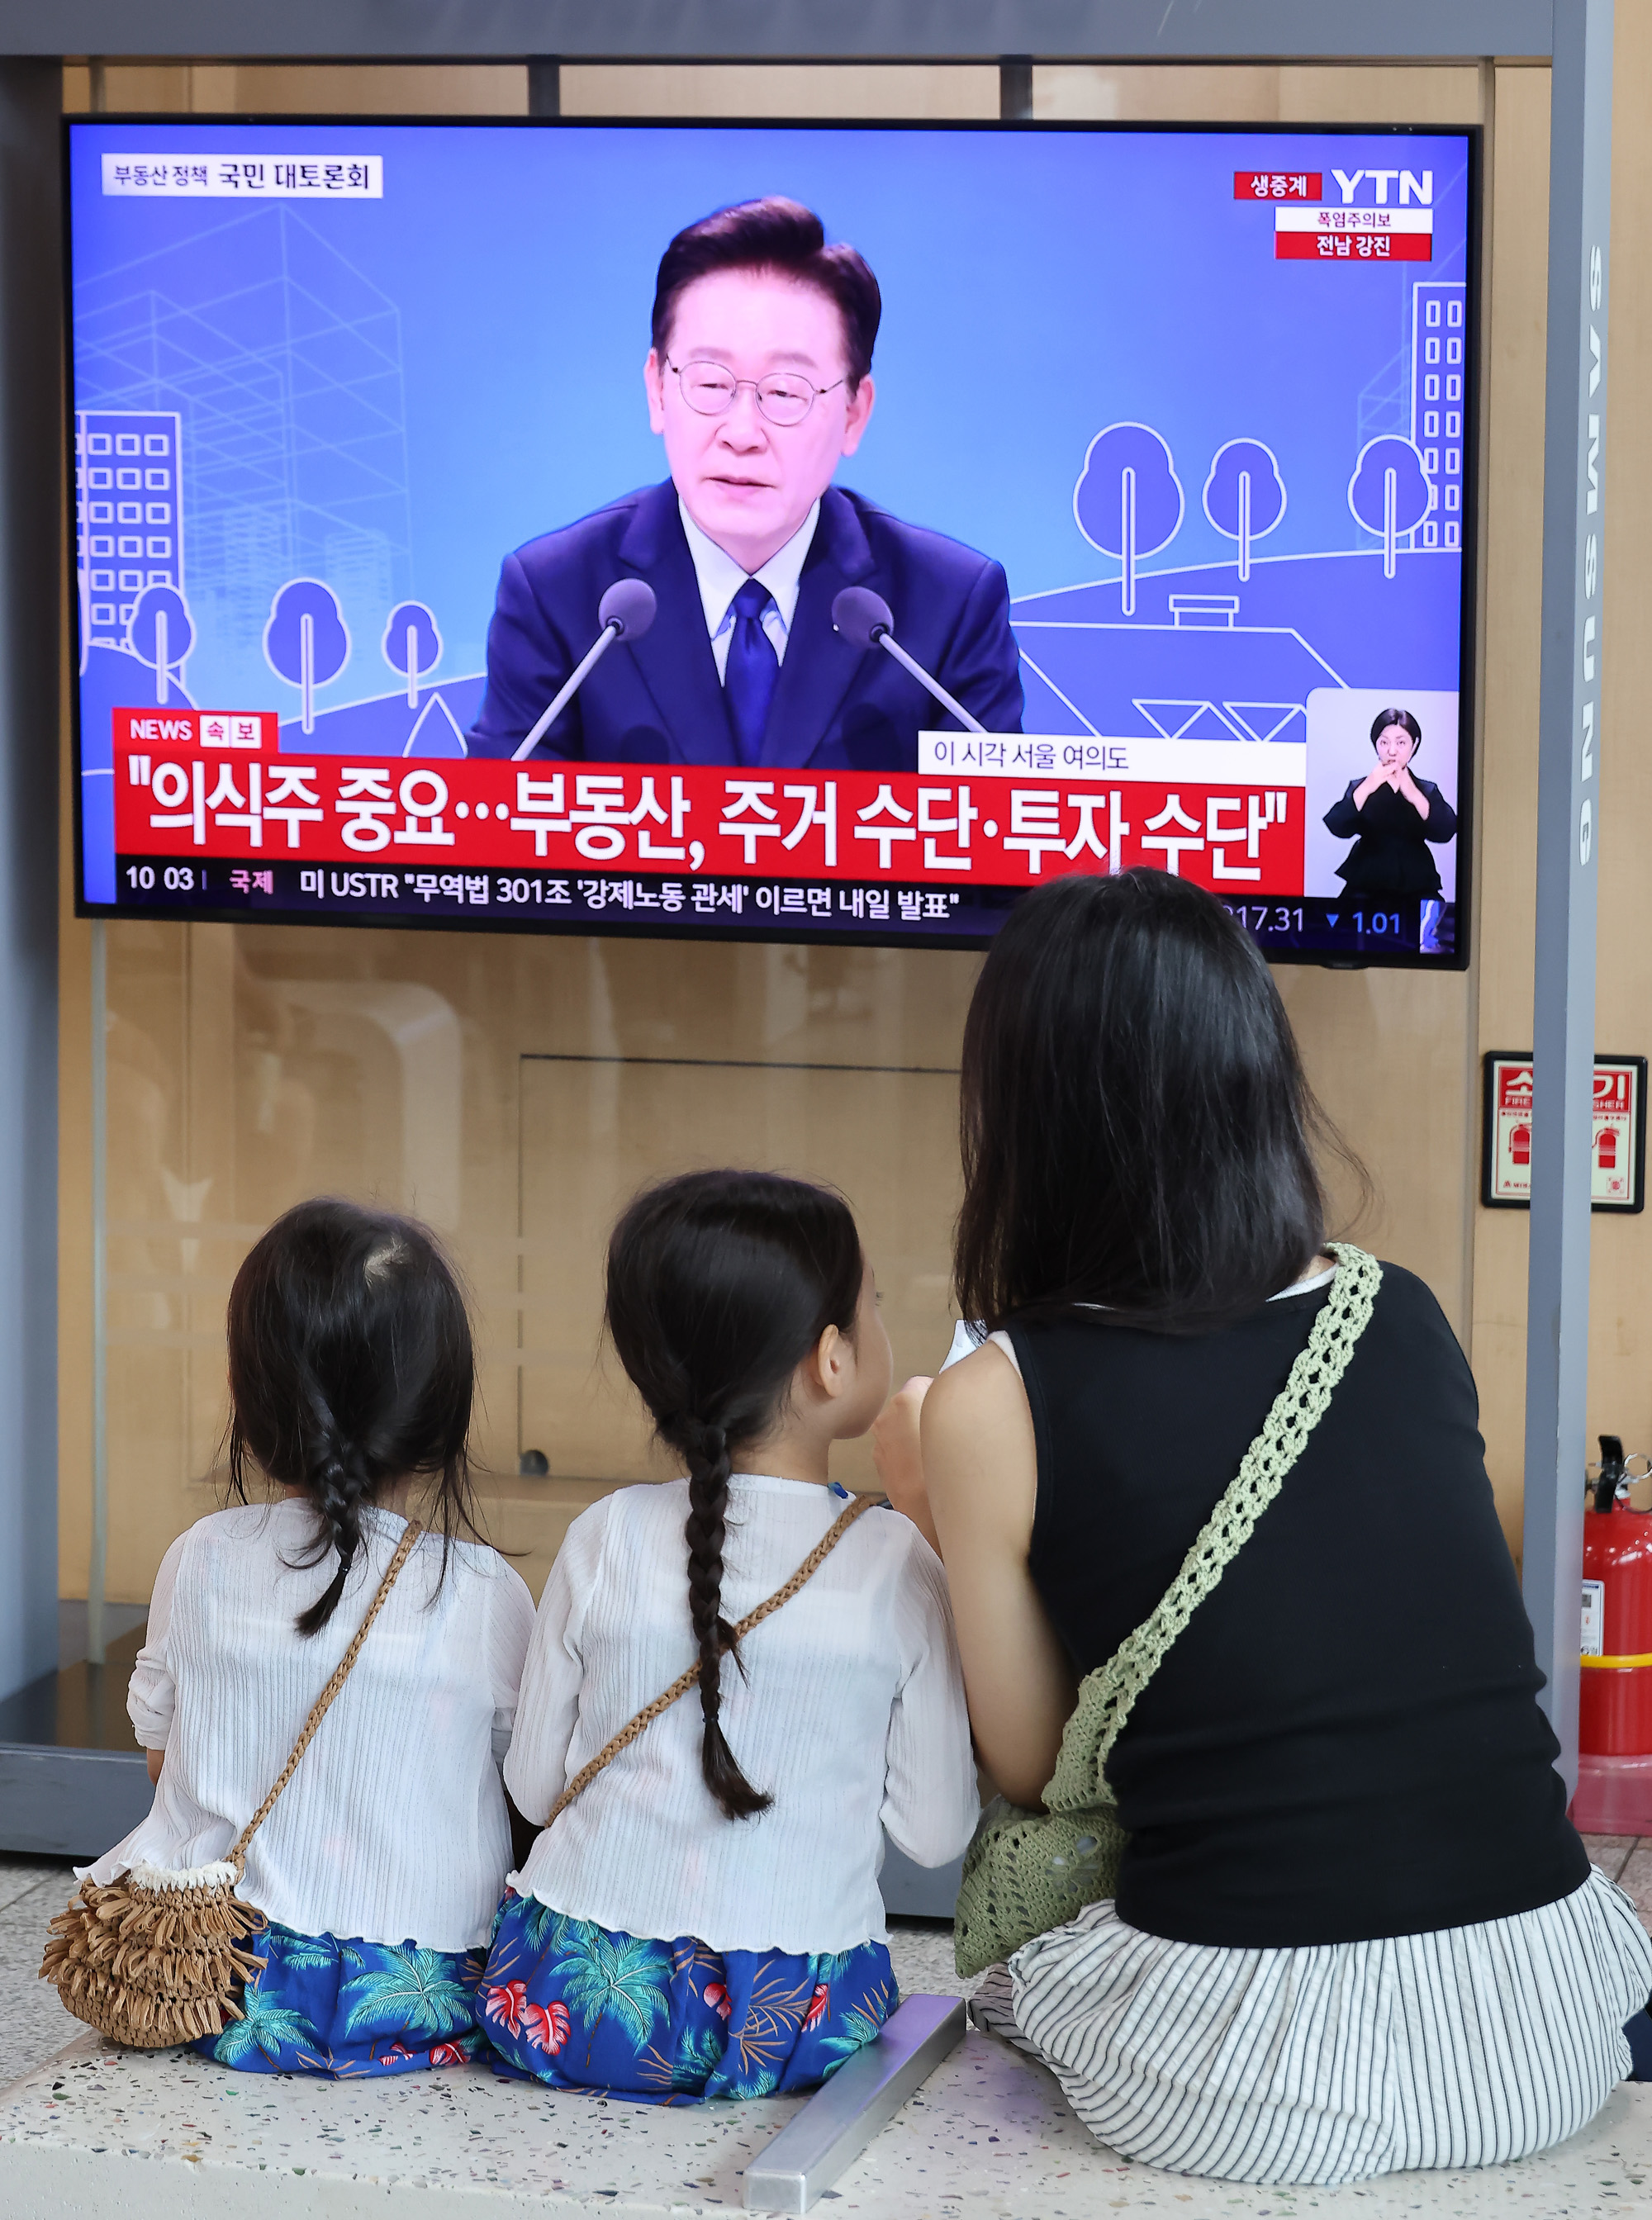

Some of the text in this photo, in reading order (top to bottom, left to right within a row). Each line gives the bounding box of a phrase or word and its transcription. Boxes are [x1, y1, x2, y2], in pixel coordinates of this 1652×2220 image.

[114, 164, 369, 190] 부동산 정책 국민 대토론회
[1250, 173, 1308, 198] 생중계
[1329, 168, 1434, 206] YTN
[1317, 211, 1392, 229] 폭염주의보
[1316, 235, 1391, 258] 전남 강진
[1578, 244, 1603, 868] SAMSUNG
[129, 718, 255, 742] NEWS 속보
[934, 741, 1129, 771] 이 시각 서울 여의도
[127, 754, 325, 849] "의식주
[718, 779, 838, 866] 주거
[1141, 790, 1289, 881] 수단"
[229, 868, 274, 895] 국제
[300, 869, 325, 899] 미
[331, 871, 400, 899] USTR
[404, 872, 490, 906] "무역법
[496, 877, 572, 906] 301조
[577, 878, 686, 913] '강제노동
[690, 882, 750, 914] 관세'
[755, 884, 832, 919] 이르면
[838, 888, 890, 921] 내일
[897, 889, 960, 922] 발표"
[1222, 905, 1401, 934] 17.31 1.01
[1505, 1070, 1626, 1100] 소기
